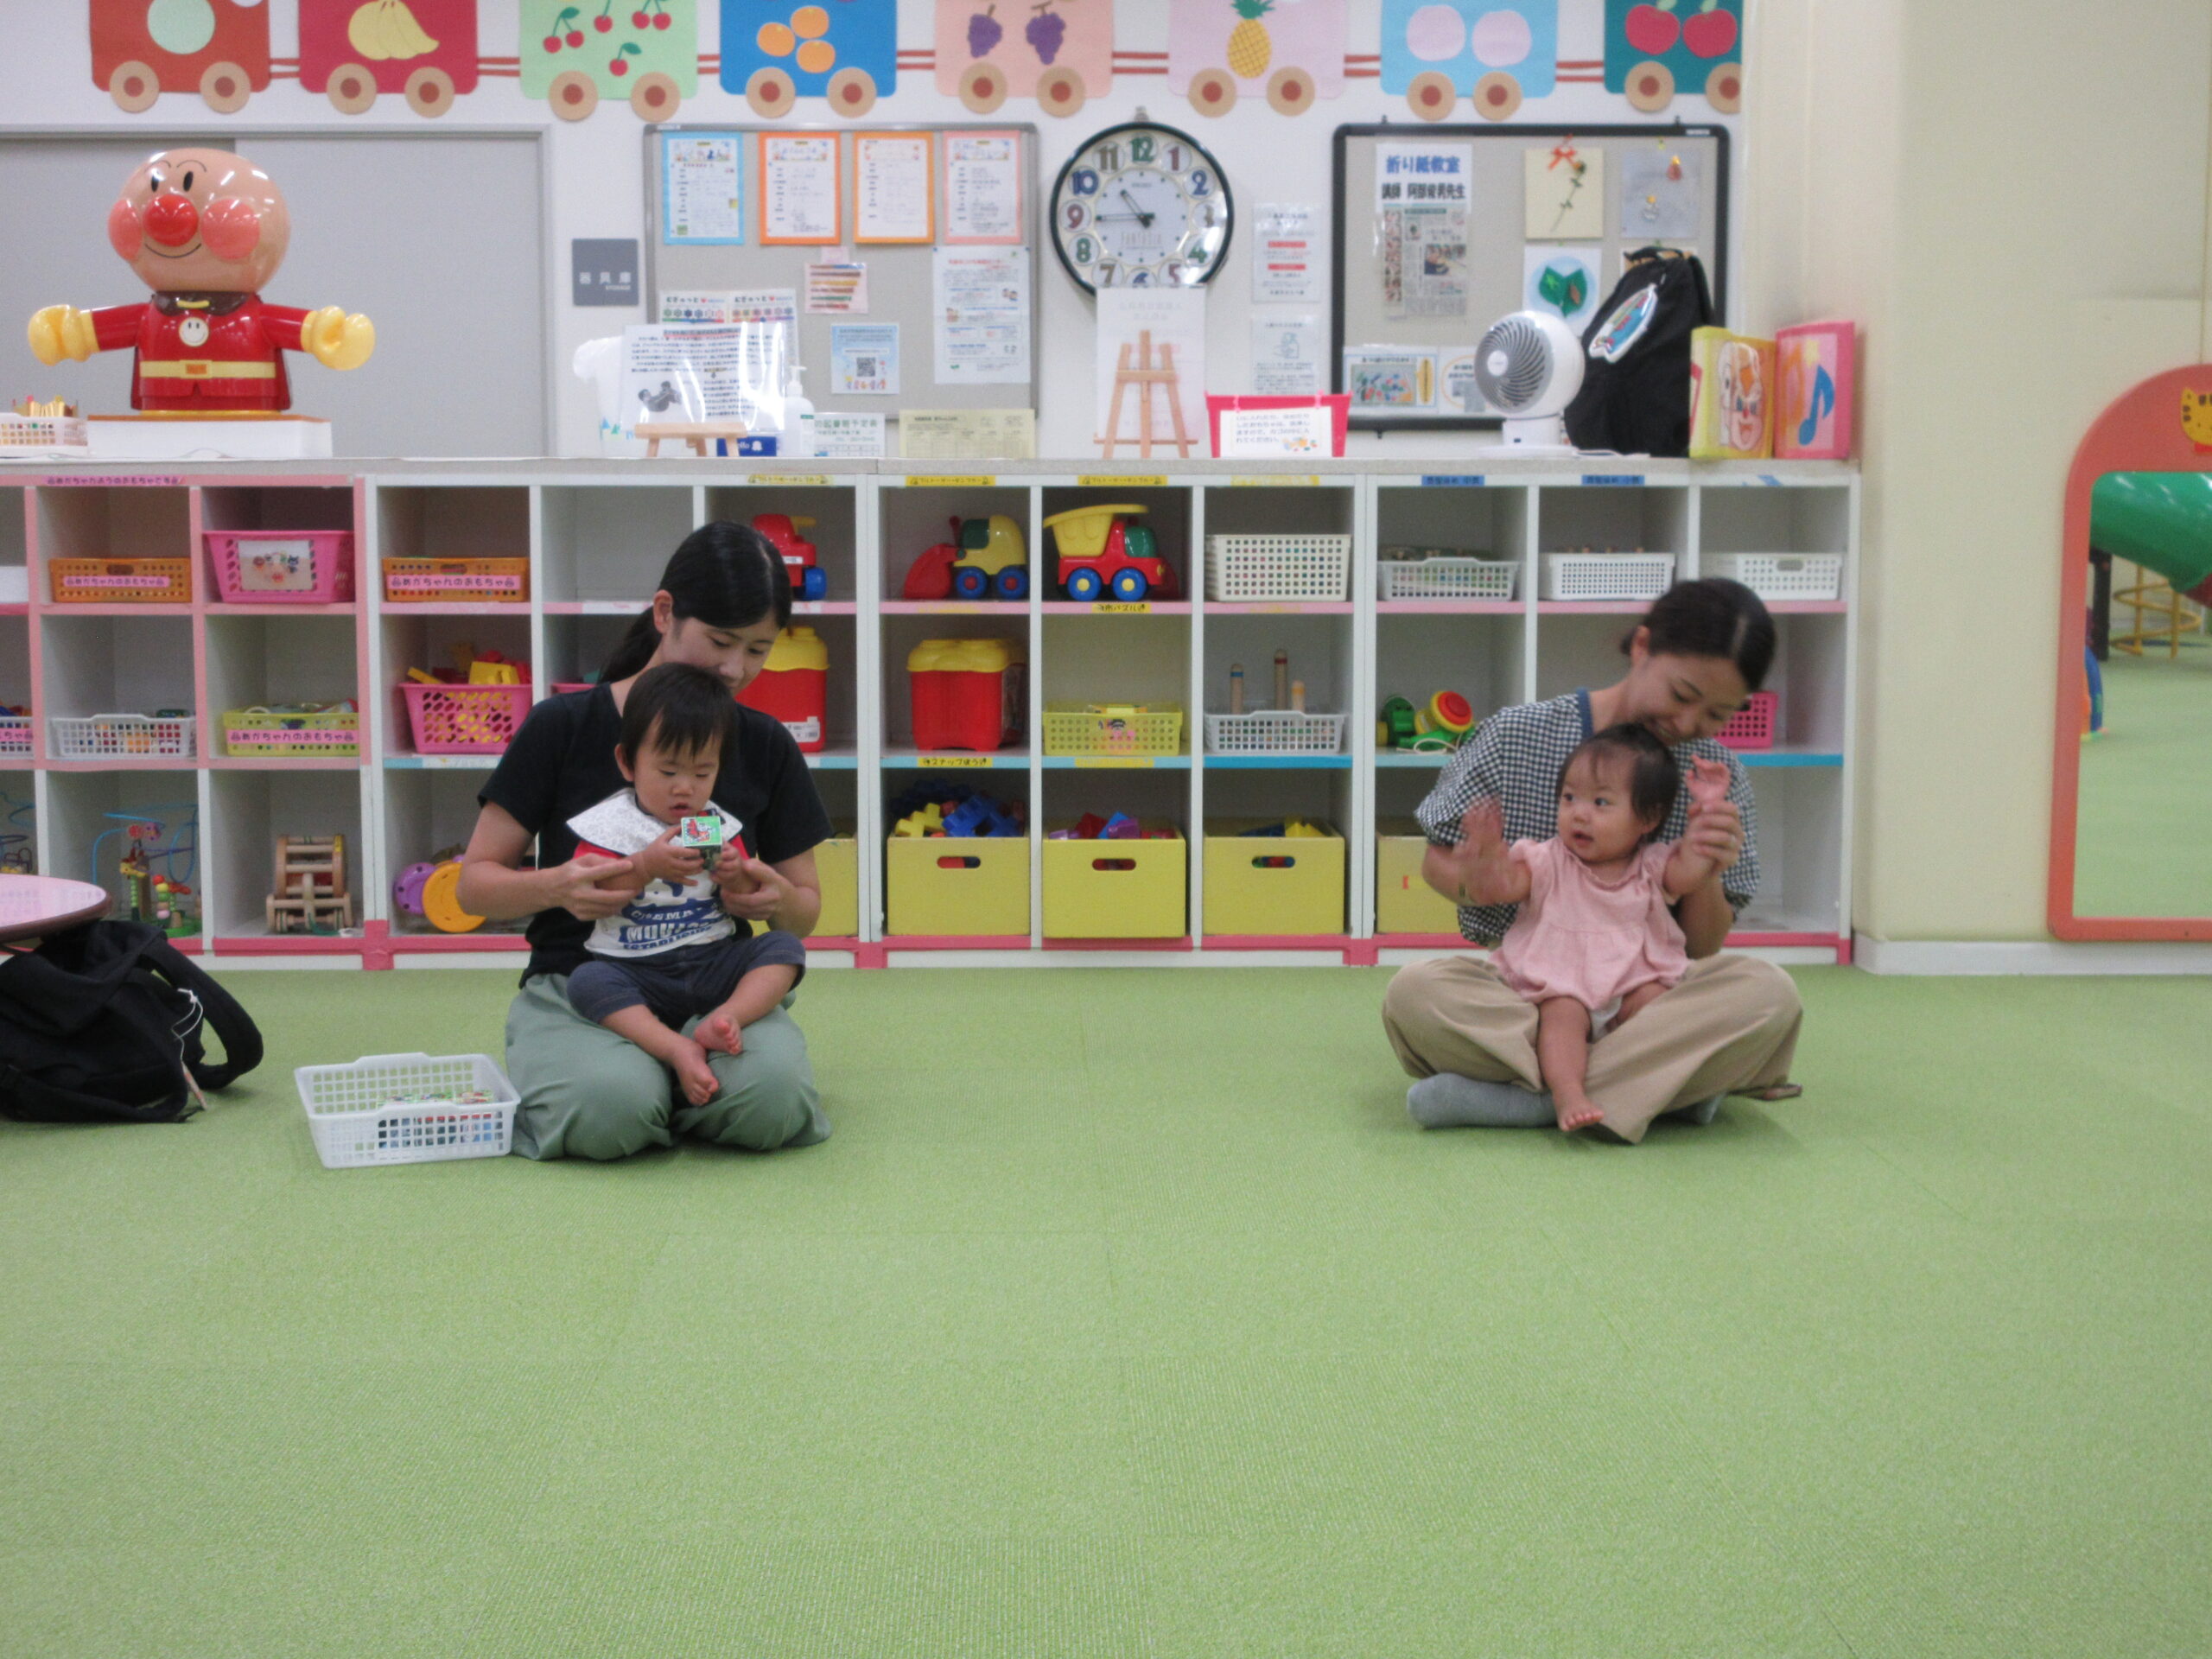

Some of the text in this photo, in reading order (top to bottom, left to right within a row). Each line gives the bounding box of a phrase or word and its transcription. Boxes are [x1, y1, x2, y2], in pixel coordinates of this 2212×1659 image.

[1097, 146, 1119, 171] 11
[1129, 137, 1156, 163] 12
[1168, 146, 1179, 171] 1
[1386, 156, 1460, 174] 折り紙教室
[1071, 170, 1098, 195] 10
[1192, 170, 1210, 195] 2
[1066, 203, 1084, 229] 9
[1076, 238, 1092, 263] 8
[1187, 243, 1208, 264] 4
[1099, 264, 1116, 288] 7
[402, 577, 504, 586] あかちゃんのおもちゃ
[241, 733, 343, 741] あかちゃんのおもちゃ
